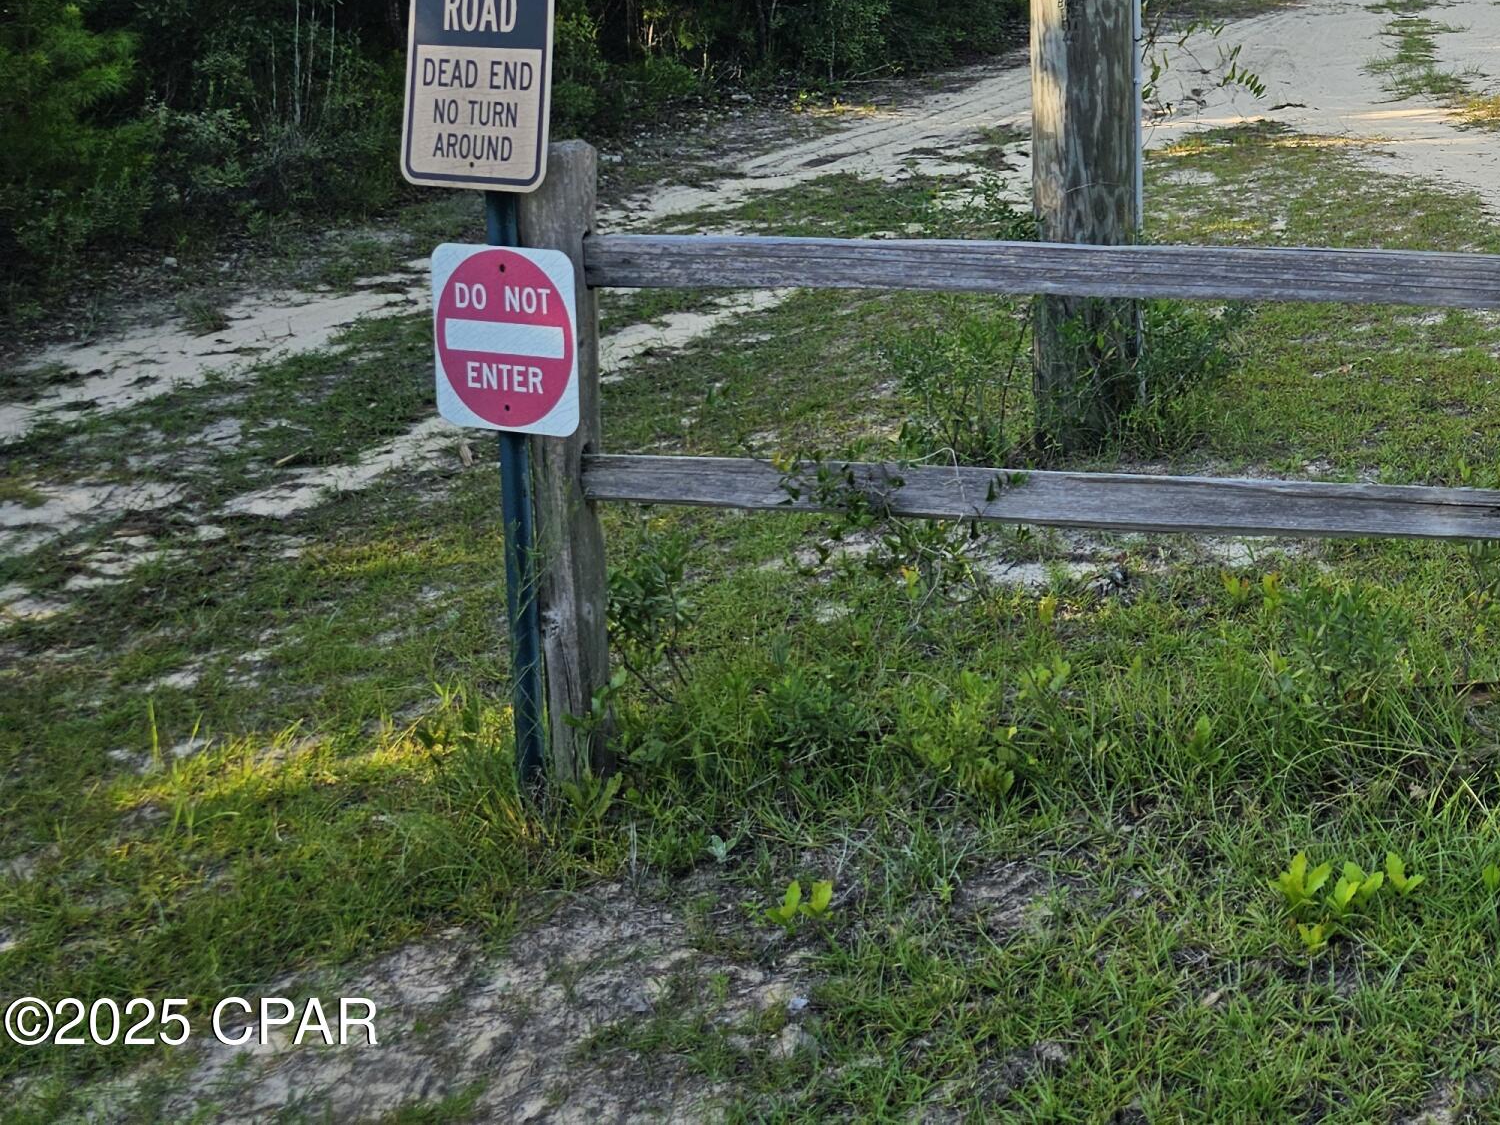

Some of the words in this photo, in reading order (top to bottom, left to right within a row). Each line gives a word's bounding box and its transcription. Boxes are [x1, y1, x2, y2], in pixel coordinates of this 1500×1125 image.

[423, 58, 478, 88] DEAD
[489, 60, 533, 90] END
[433, 98, 459, 124] NO
[468, 100, 518, 128] TURN
[432, 132, 512, 162] AROUND
[455, 282, 487, 310] DO
[504, 285, 551, 315] NOT
[466, 361, 544, 394] ENTER
